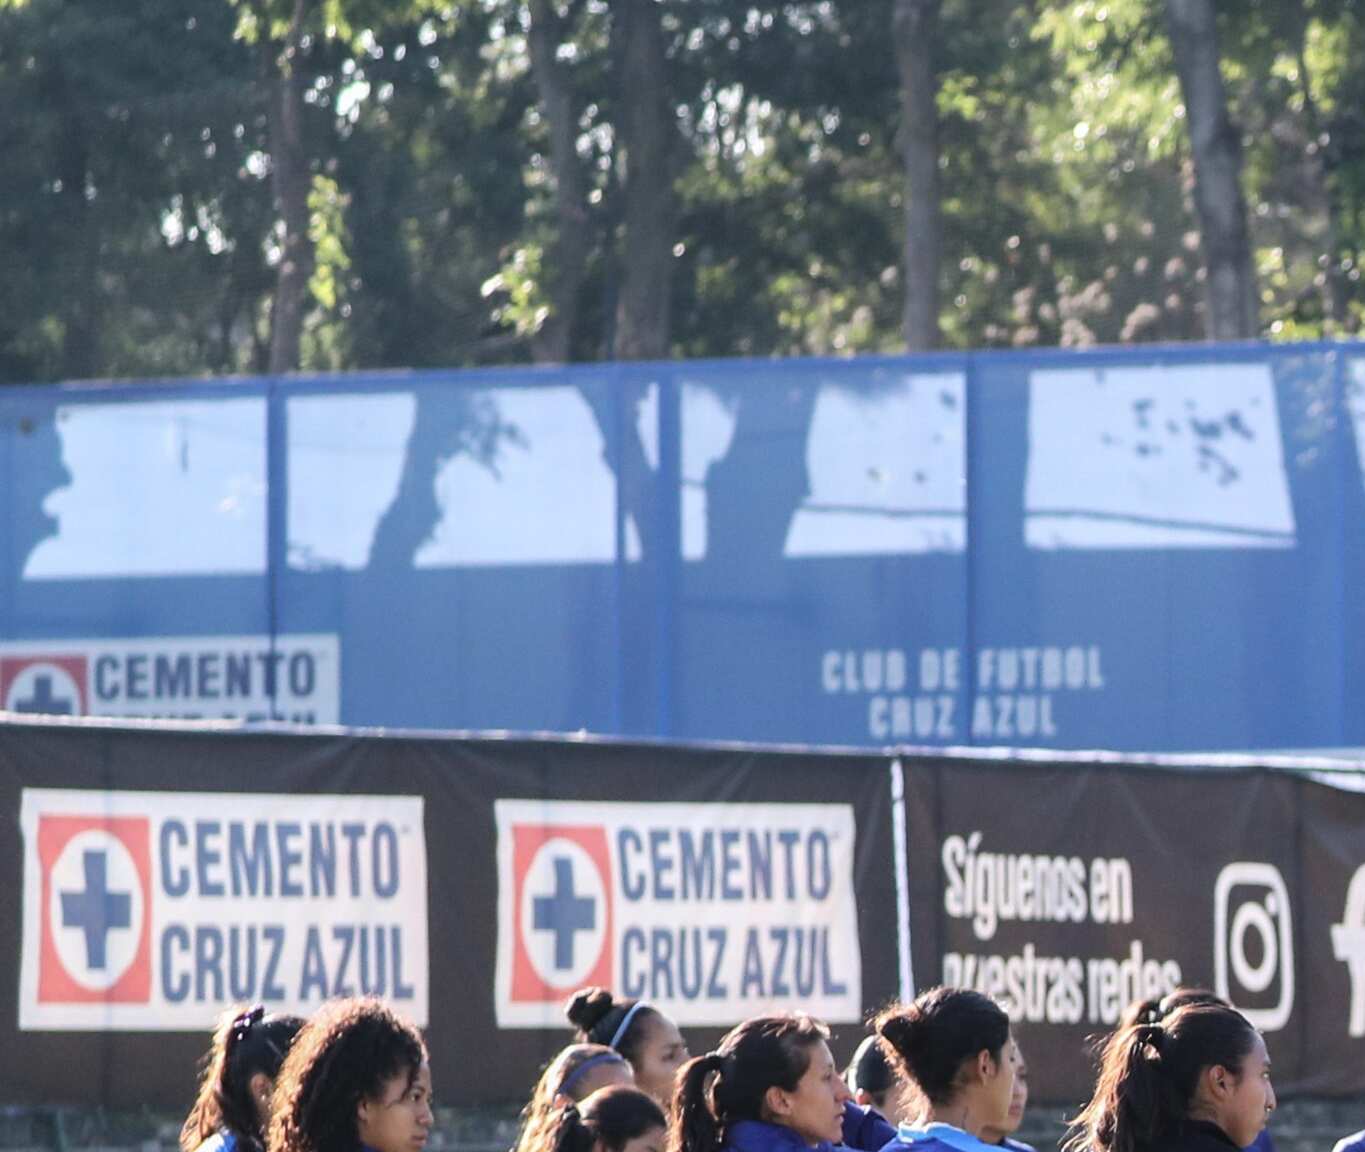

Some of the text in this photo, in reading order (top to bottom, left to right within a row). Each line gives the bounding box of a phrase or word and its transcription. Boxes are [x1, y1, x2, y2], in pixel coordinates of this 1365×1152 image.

[95, 650, 316, 701] CEMENTO
[820, 645, 1105, 693] CLUB DE FUTBOL
[972, 694, 1058, 738] AZUL
[159, 819, 401, 899] CEMENTO
[617, 828, 834, 904] CEMENTO
[942, 831, 1134, 940] Síguenos en
[160, 922, 415, 1003] CRUZ AZUL
[619, 924, 847, 1000] CRUZ AZUL
[1087, 938, 1182, 1024] redes
